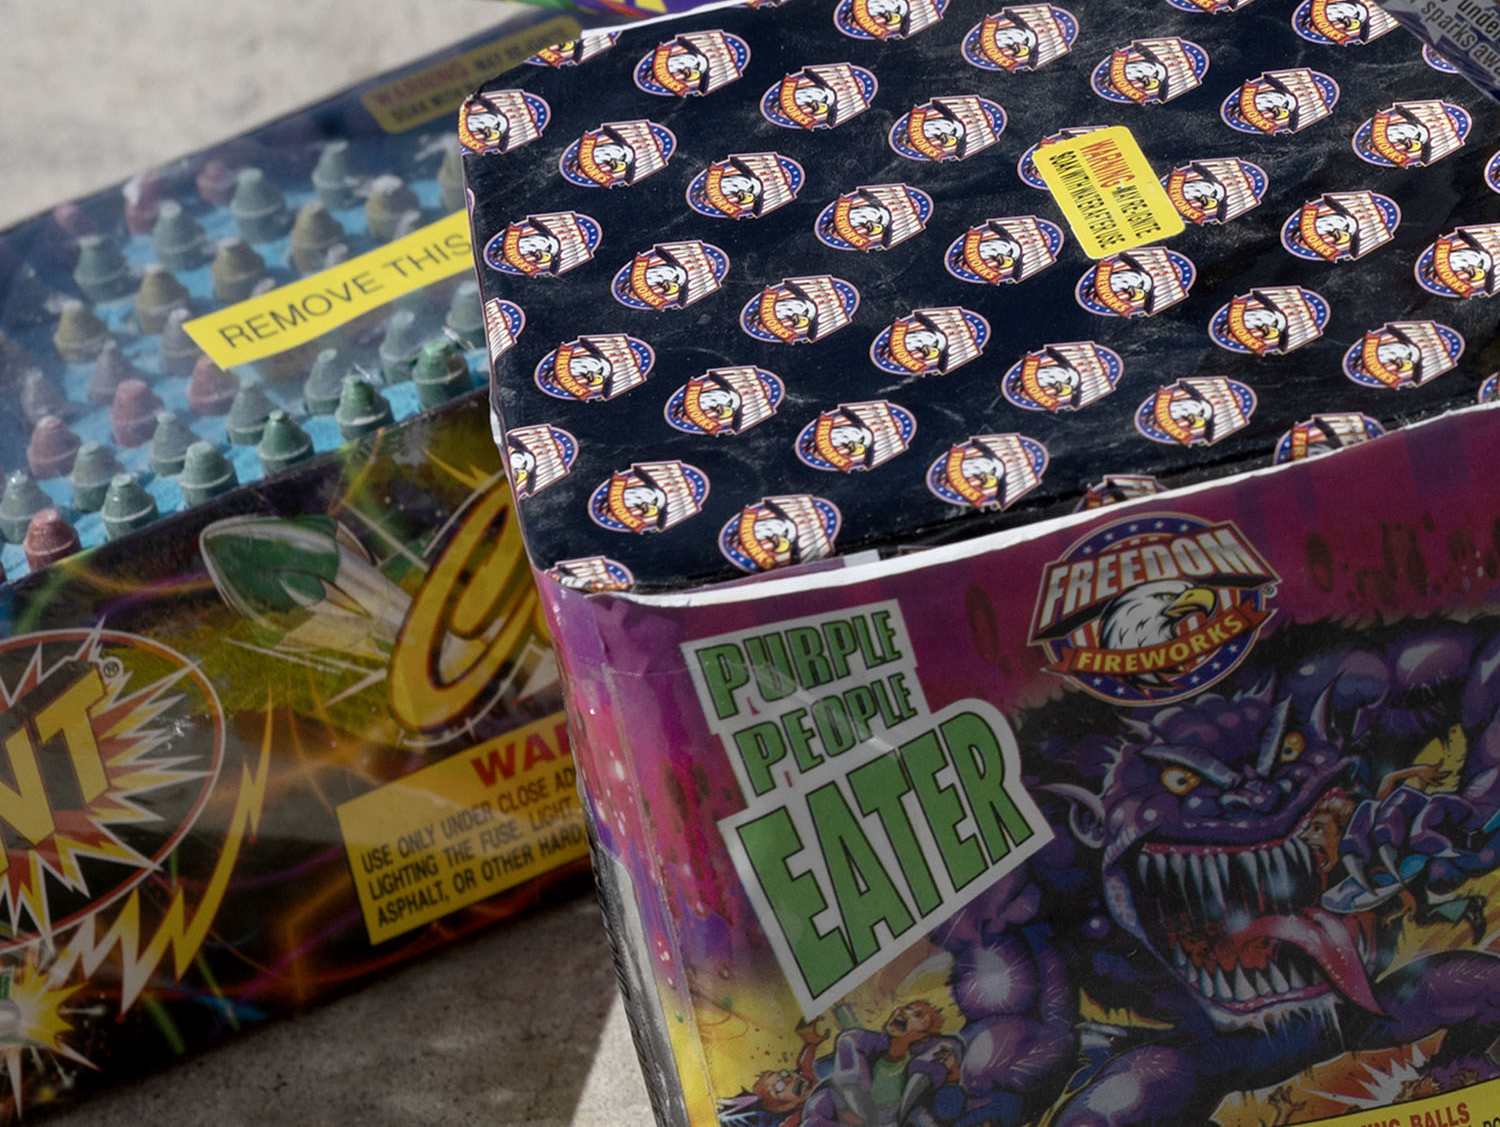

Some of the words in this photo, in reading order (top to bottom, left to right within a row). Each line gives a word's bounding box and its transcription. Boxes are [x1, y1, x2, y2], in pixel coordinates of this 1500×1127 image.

[1059, 168, 1091, 191] WITH
[1069, 185, 1105, 213] WATER
[1078, 137, 1136, 189] WARNING
[1082, 207, 1117, 234] AFTER
[218, 270, 385, 349] REMOVE
[381, 233, 473, 278] THIS
[1039, 529, 1266, 631] FREEDOM
[695, 609, 903, 721] PURPLE
[1075, 613, 1245, 673] FIREWORKS
[732, 672, 919, 797] PEOPLE
[360, 842, 394, 874] USE
[397, 824, 437, 858] ONLY
[441, 800, 493, 840] UNDER
[496, 776, 550, 815] CLOSE
[367, 854, 440, 902] LIGHTING
[443, 840, 474, 869] THE
[480, 819, 520, 853] FUSE
[527, 795, 573, 832] LIGHT
[735, 711, 1035, 1001] EATER
[375, 880, 451, 930] ASPHALT,
[453, 868, 477, 895] OR
[480, 848, 536, 883] OTHER
[1409, 1101, 1471, 1127] BALLS
